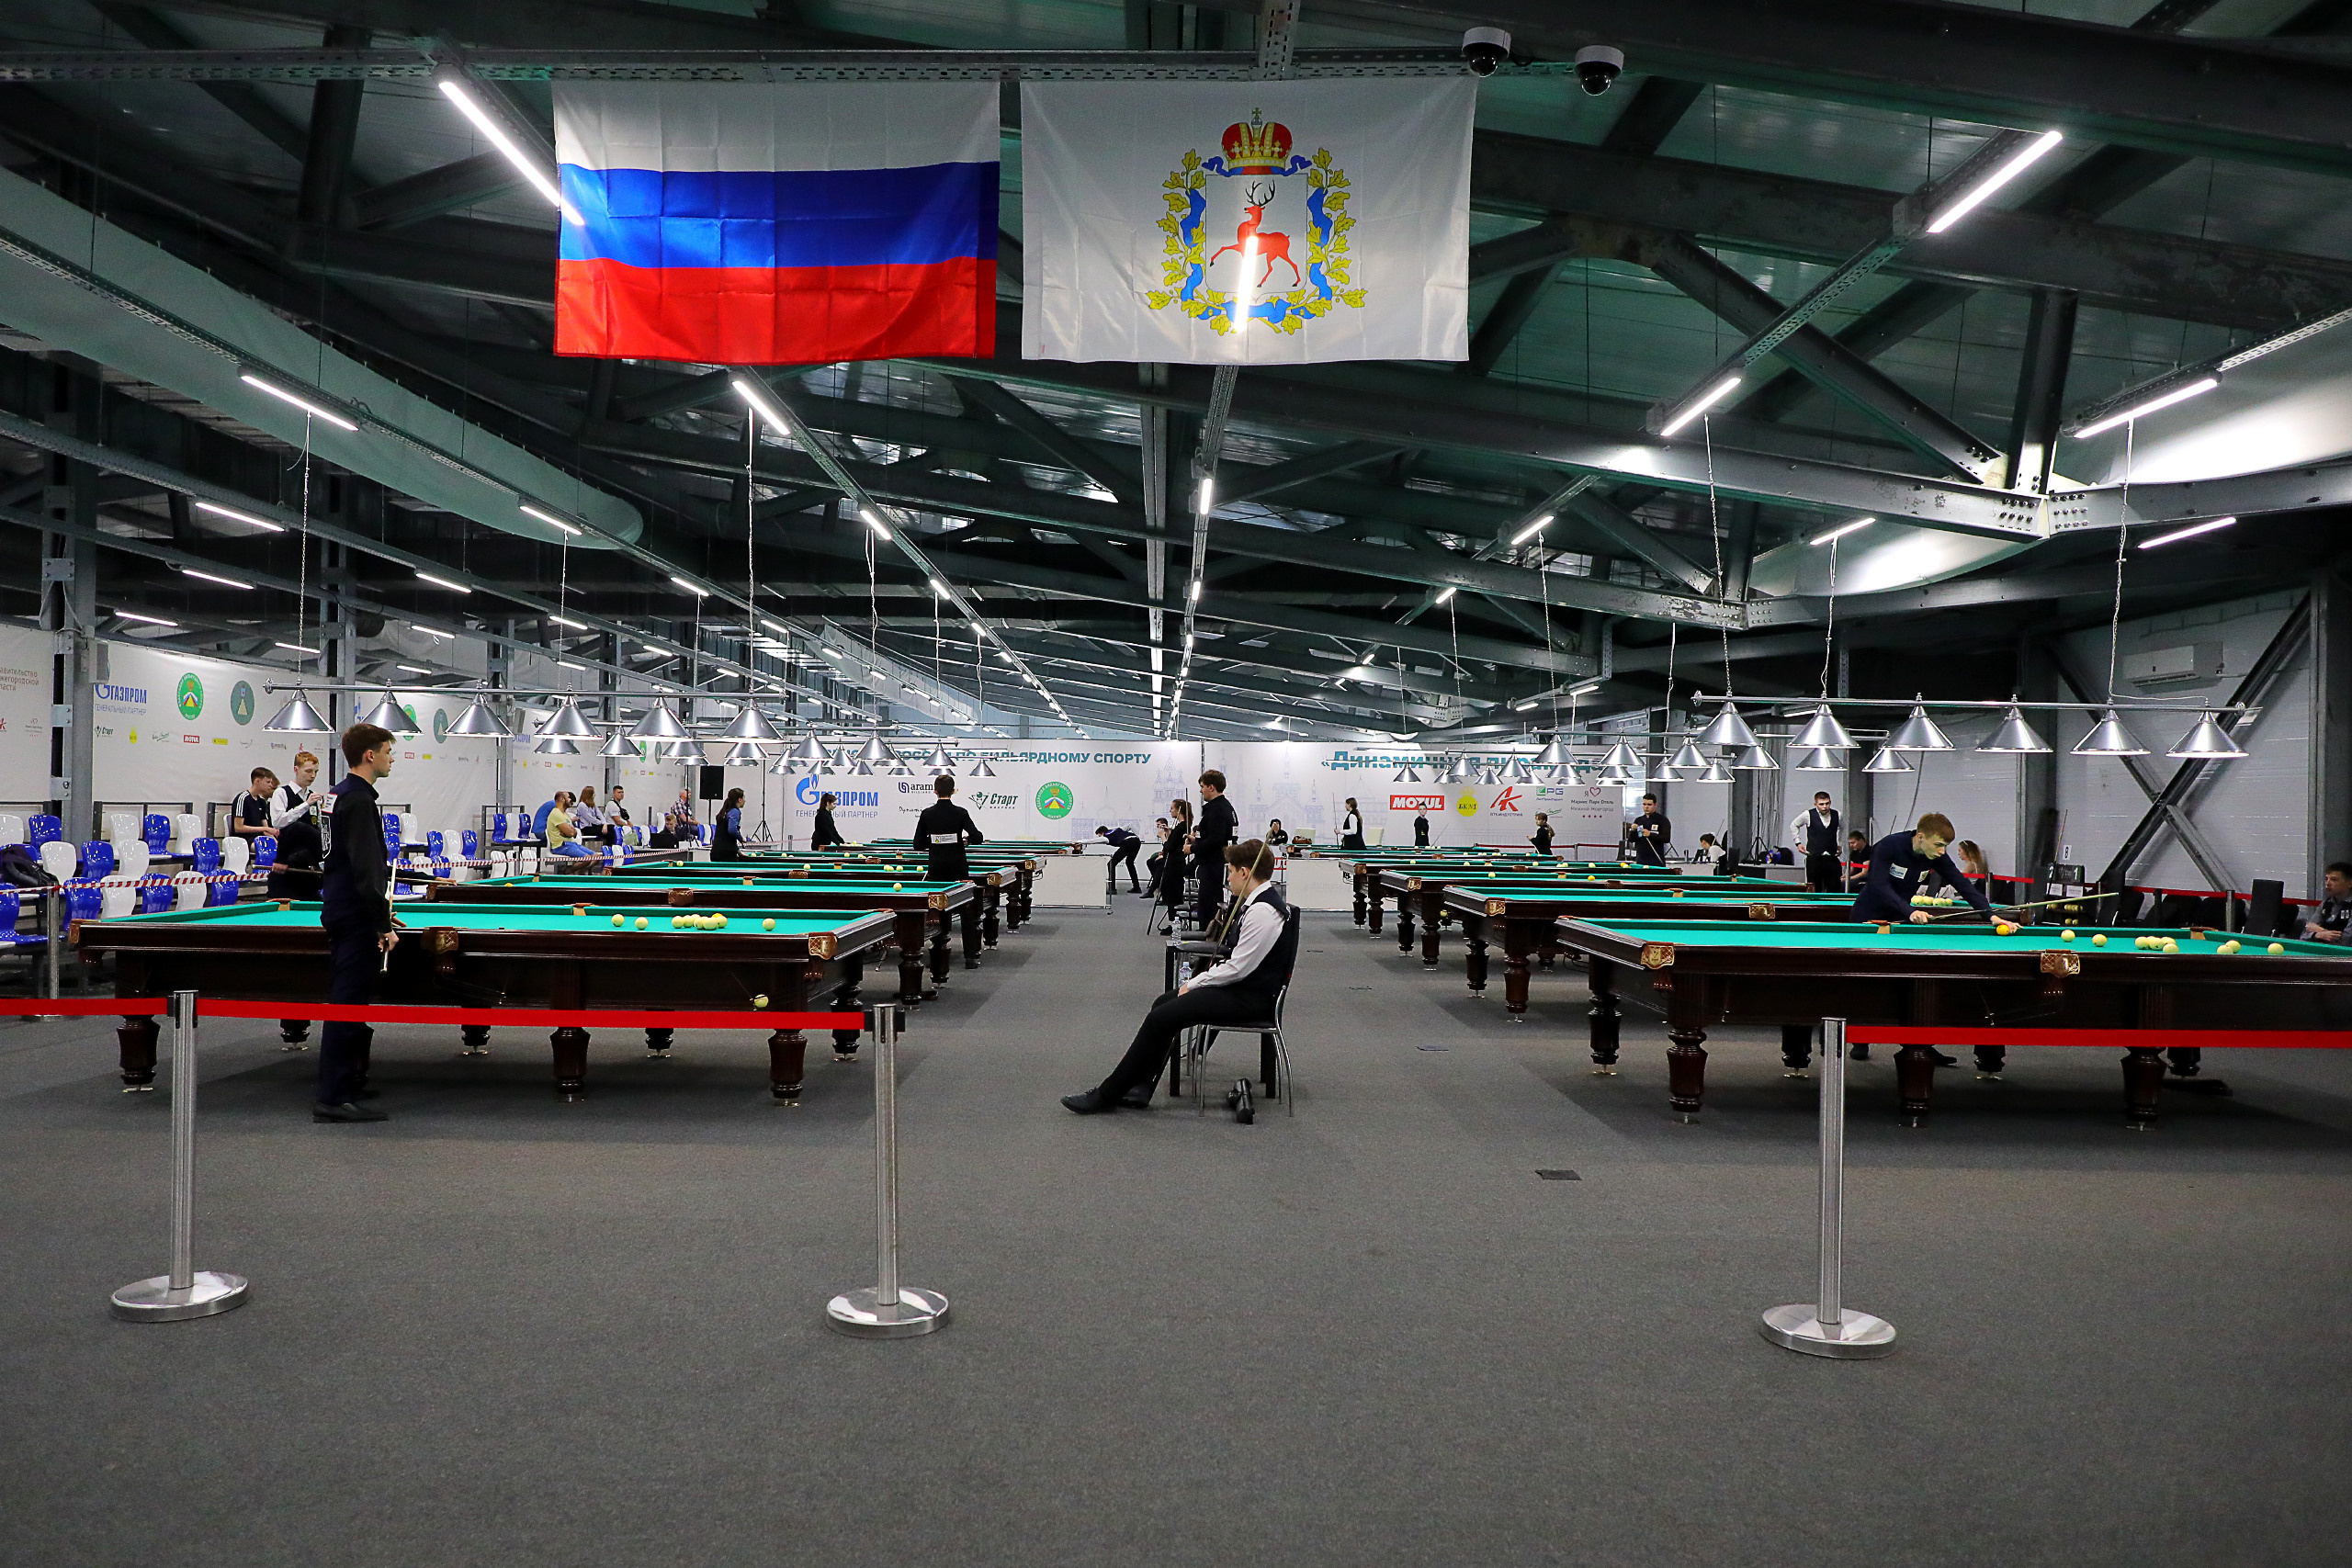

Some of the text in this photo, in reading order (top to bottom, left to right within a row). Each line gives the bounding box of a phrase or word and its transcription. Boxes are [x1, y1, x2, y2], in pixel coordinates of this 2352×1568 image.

[110, 685, 147, 704] ГАЗПРОМ
[184, 735, 199, 743] MOTUL
[1093, 752, 1152, 764] СПОРТУ
[910, 783, 933, 791] aram
[820, 791, 878, 807] ЗПРОМ
[989, 793, 1019, 807] Старт
[847, 810, 878, 818] ПАРТНЕР
[899, 806, 922, 815] Dynami
[2074, 867, 2078, 880] 1
